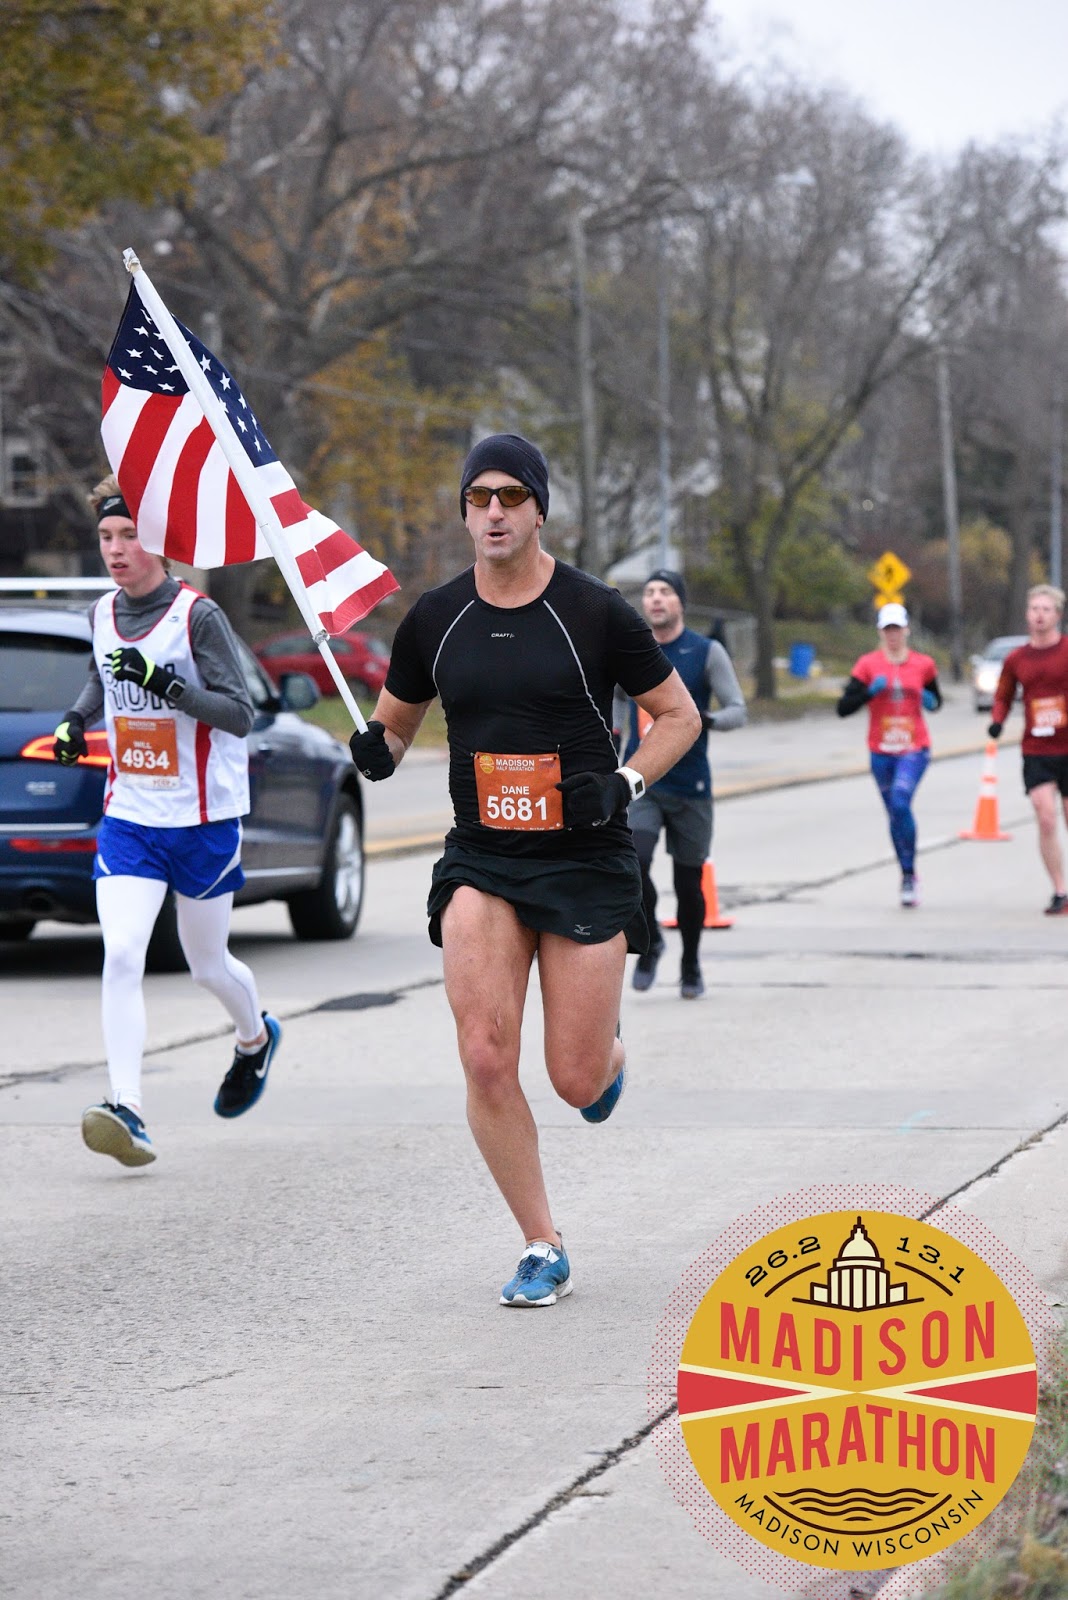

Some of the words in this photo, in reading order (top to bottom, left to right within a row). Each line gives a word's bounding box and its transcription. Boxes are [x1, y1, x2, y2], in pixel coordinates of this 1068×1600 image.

[133, 740, 152, 749] WILL
[121, 748, 170, 770] 4934
[495, 758, 535, 767] MADISON
[501, 785, 530, 795] DANE
[487, 795, 547, 821] 5681
